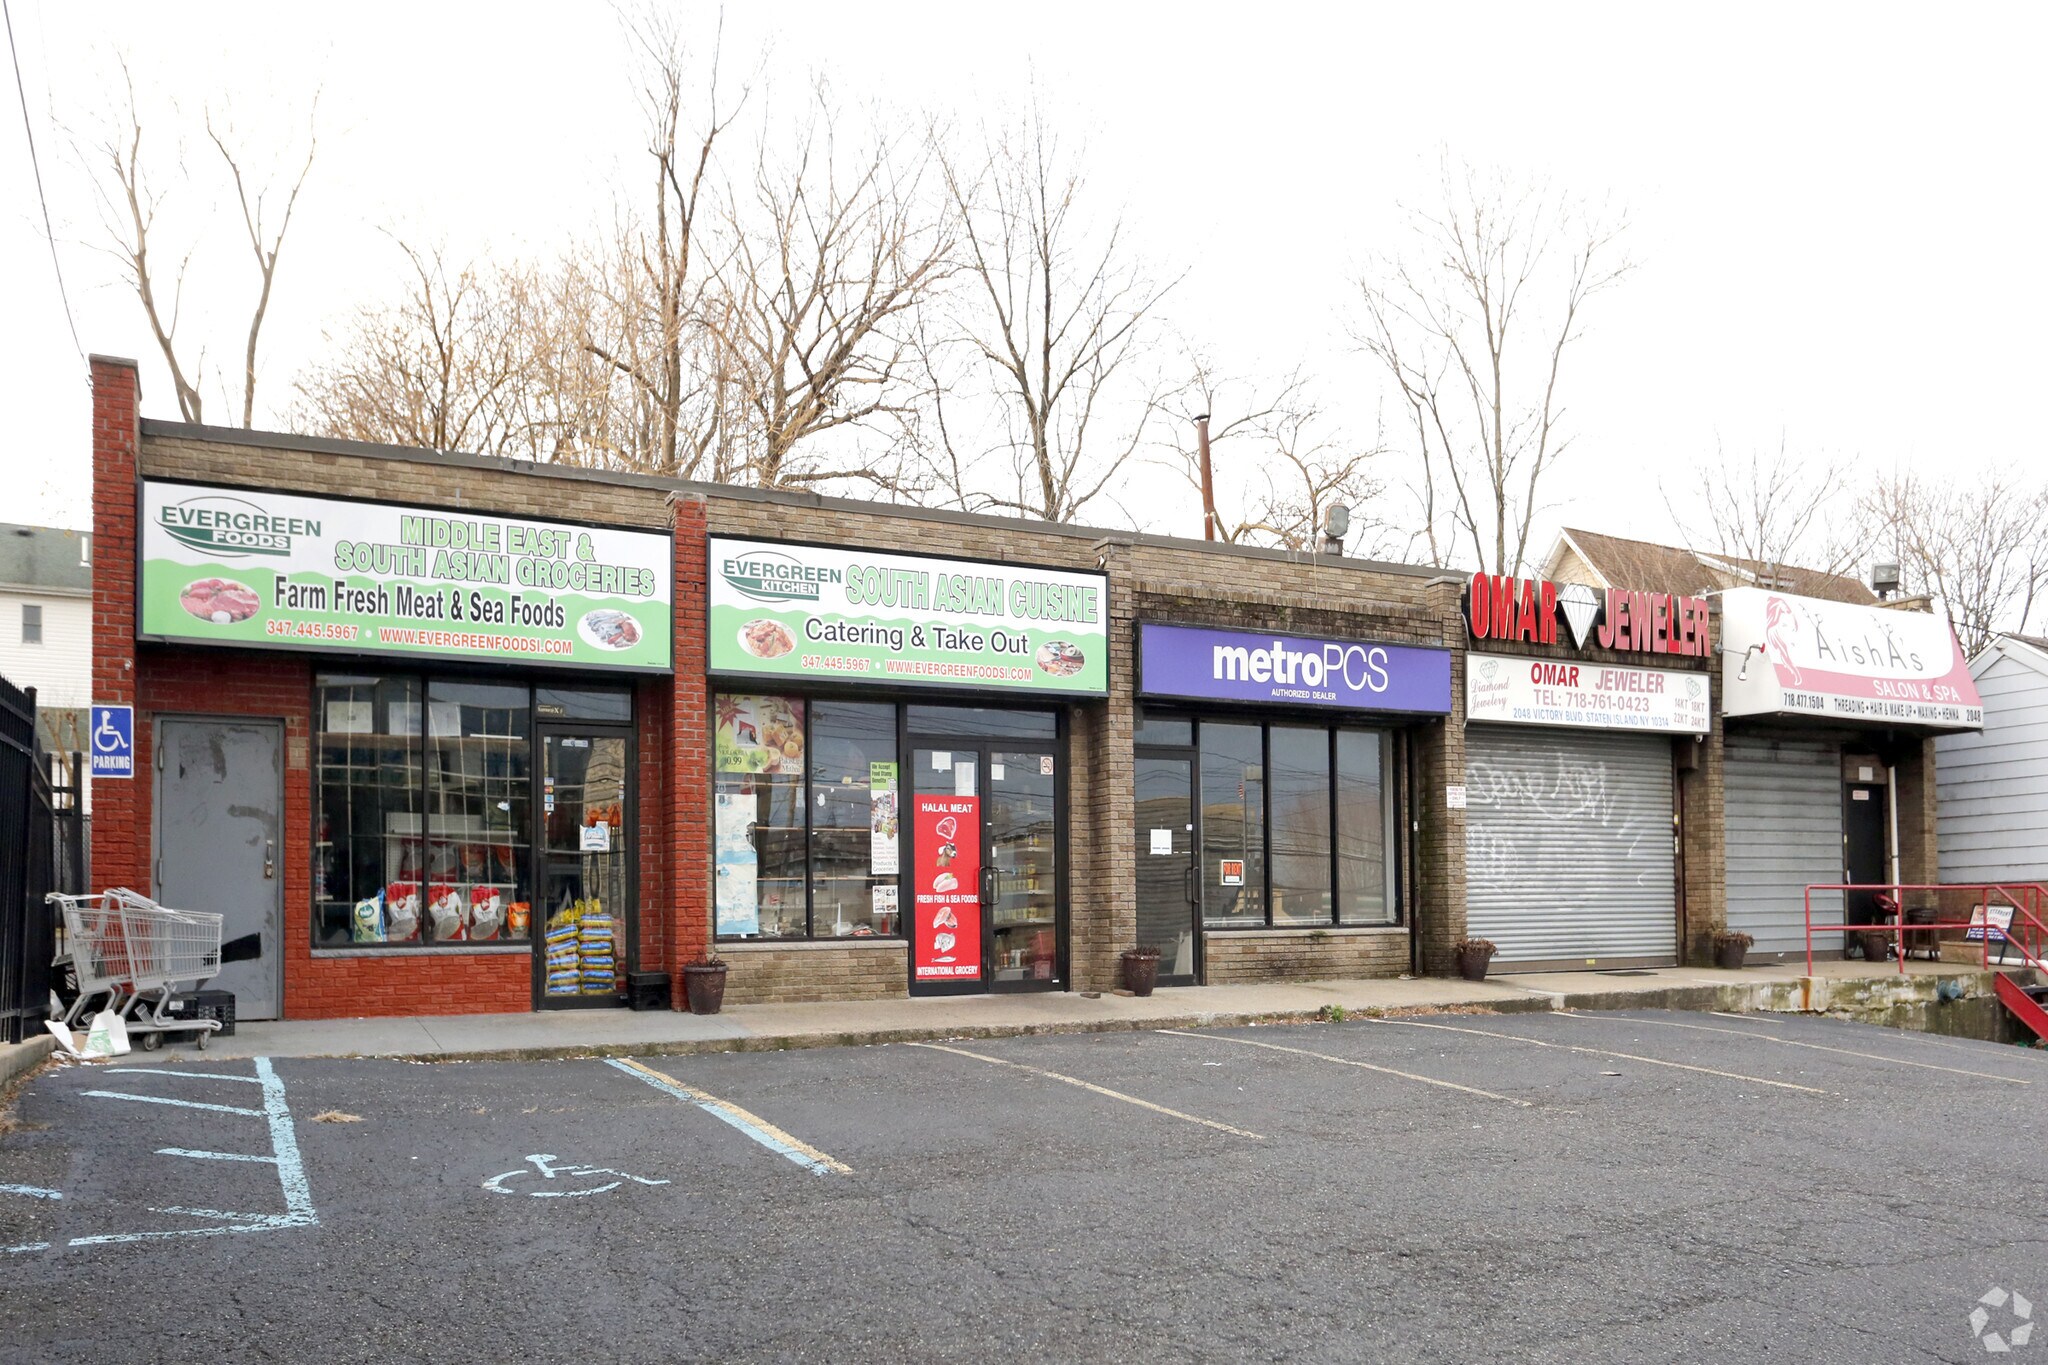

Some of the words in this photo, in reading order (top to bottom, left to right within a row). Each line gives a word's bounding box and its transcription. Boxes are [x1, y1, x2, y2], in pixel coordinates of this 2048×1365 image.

[161, 505, 322, 537] EVERGREEN
[212, 530, 288, 549] FOODS
[401, 514, 500, 552] MIDDLE
[507, 525, 571, 559] EAST
[576, 532, 596, 562] &
[335, 540, 427, 577] SOUTH
[431, 550, 510, 584] ASIAN
[516, 557, 656, 597] GROCERIES
[723, 559, 842, 584] EVERGREEN
[761, 579, 817, 594] KITCHEN
[845, 564, 929, 610] SOUTH
[933, 573, 1004, 616] ASIAN
[1009, 579, 1098, 624] CUISINE
[275, 576, 326, 609] Farm
[334, 580, 389, 615] Fresh
[396, 585, 443, 618] Meat
[450, 590, 463, 620] &
[470, 591, 503, 623] Sea
[511, 595, 564, 628] Foods
[1470, 571, 1557, 645] OMAR
[1598, 587, 1711, 657] JEWELER
[266, 620, 358, 640] 347.445.5967
[380, 627, 572, 655] WWW.EVERGREENFOODSI.COM
[805, 617, 903, 651] Catering
[911, 625, 926, 647] &
[932, 627, 983, 652] Take
[991, 631, 1029, 654] Out
[802, 655, 870, 672] 347.445.5967
[886, 660, 1032, 681] WWW.EVERGREENFOODSI.COM
[1213, 640, 1389, 693] metroPCS
[1530, 662, 1580, 688] OMAR
[1595, 669, 1665, 694] JEWELER
[1271, 687, 1310, 699] AUTHORIZED
[1313, 691, 1337, 701] DEALER
[1471, 676, 1510, 693] Diamond
[1872, 679, 1920, 699] SALON
[1921, 684, 1933, 700] &
[1933, 685, 1962, 702] SPA
[1534, 688, 1562, 707] TEL:
[1566, 691, 1650, 713] 718-761-0423
[1674, 698, 1688, 710] 14KT
[1691, 701, 1705, 713] 18KT
[1784, 692, 1824, 710] 718.477.1504
[1834, 698, 1865, 714] THREADING
[1870, 701, 1883, 715] HAIR
[1889, 703, 1904, 717] MAKE
[1905, 704, 1912, 717] UP
[1917, 705, 1938, 719] WAXING
[1942, 707, 1960, 721] HENNA
[1966, 709, 1981, 722] 2048
[1513, 707, 1531, 719] 2048
[1533, 708, 1564, 721] VICTORY
[1566, 710, 1585, 723] BLVD.
[1586, 712, 1612, 725] STATEN
[1613, 713, 1639, 726] ISLAND
[1640, 715, 1650, 727] NY
[1651, 716, 1669, 727] 10314
[1691, 716, 1705, 728] 24KT
[93, 755, 131, 770] PARKING
[921, 803, 949, 813] HALAL
[950, 803, 973, 813] MEAT
[1223, 862, 1231, 875] FOR
[1231, 862, 1242, 876] RENT
[916, 894, 934, 903] FRESH
[934, 894, 946, 903] FISH
[950, 894, 961, 903] SEA
[961, 894, 978, 904] FOODS
[916, 965, 955, 976] INTERNATIONAL
[955, 965, 978, 975] GROCERY
